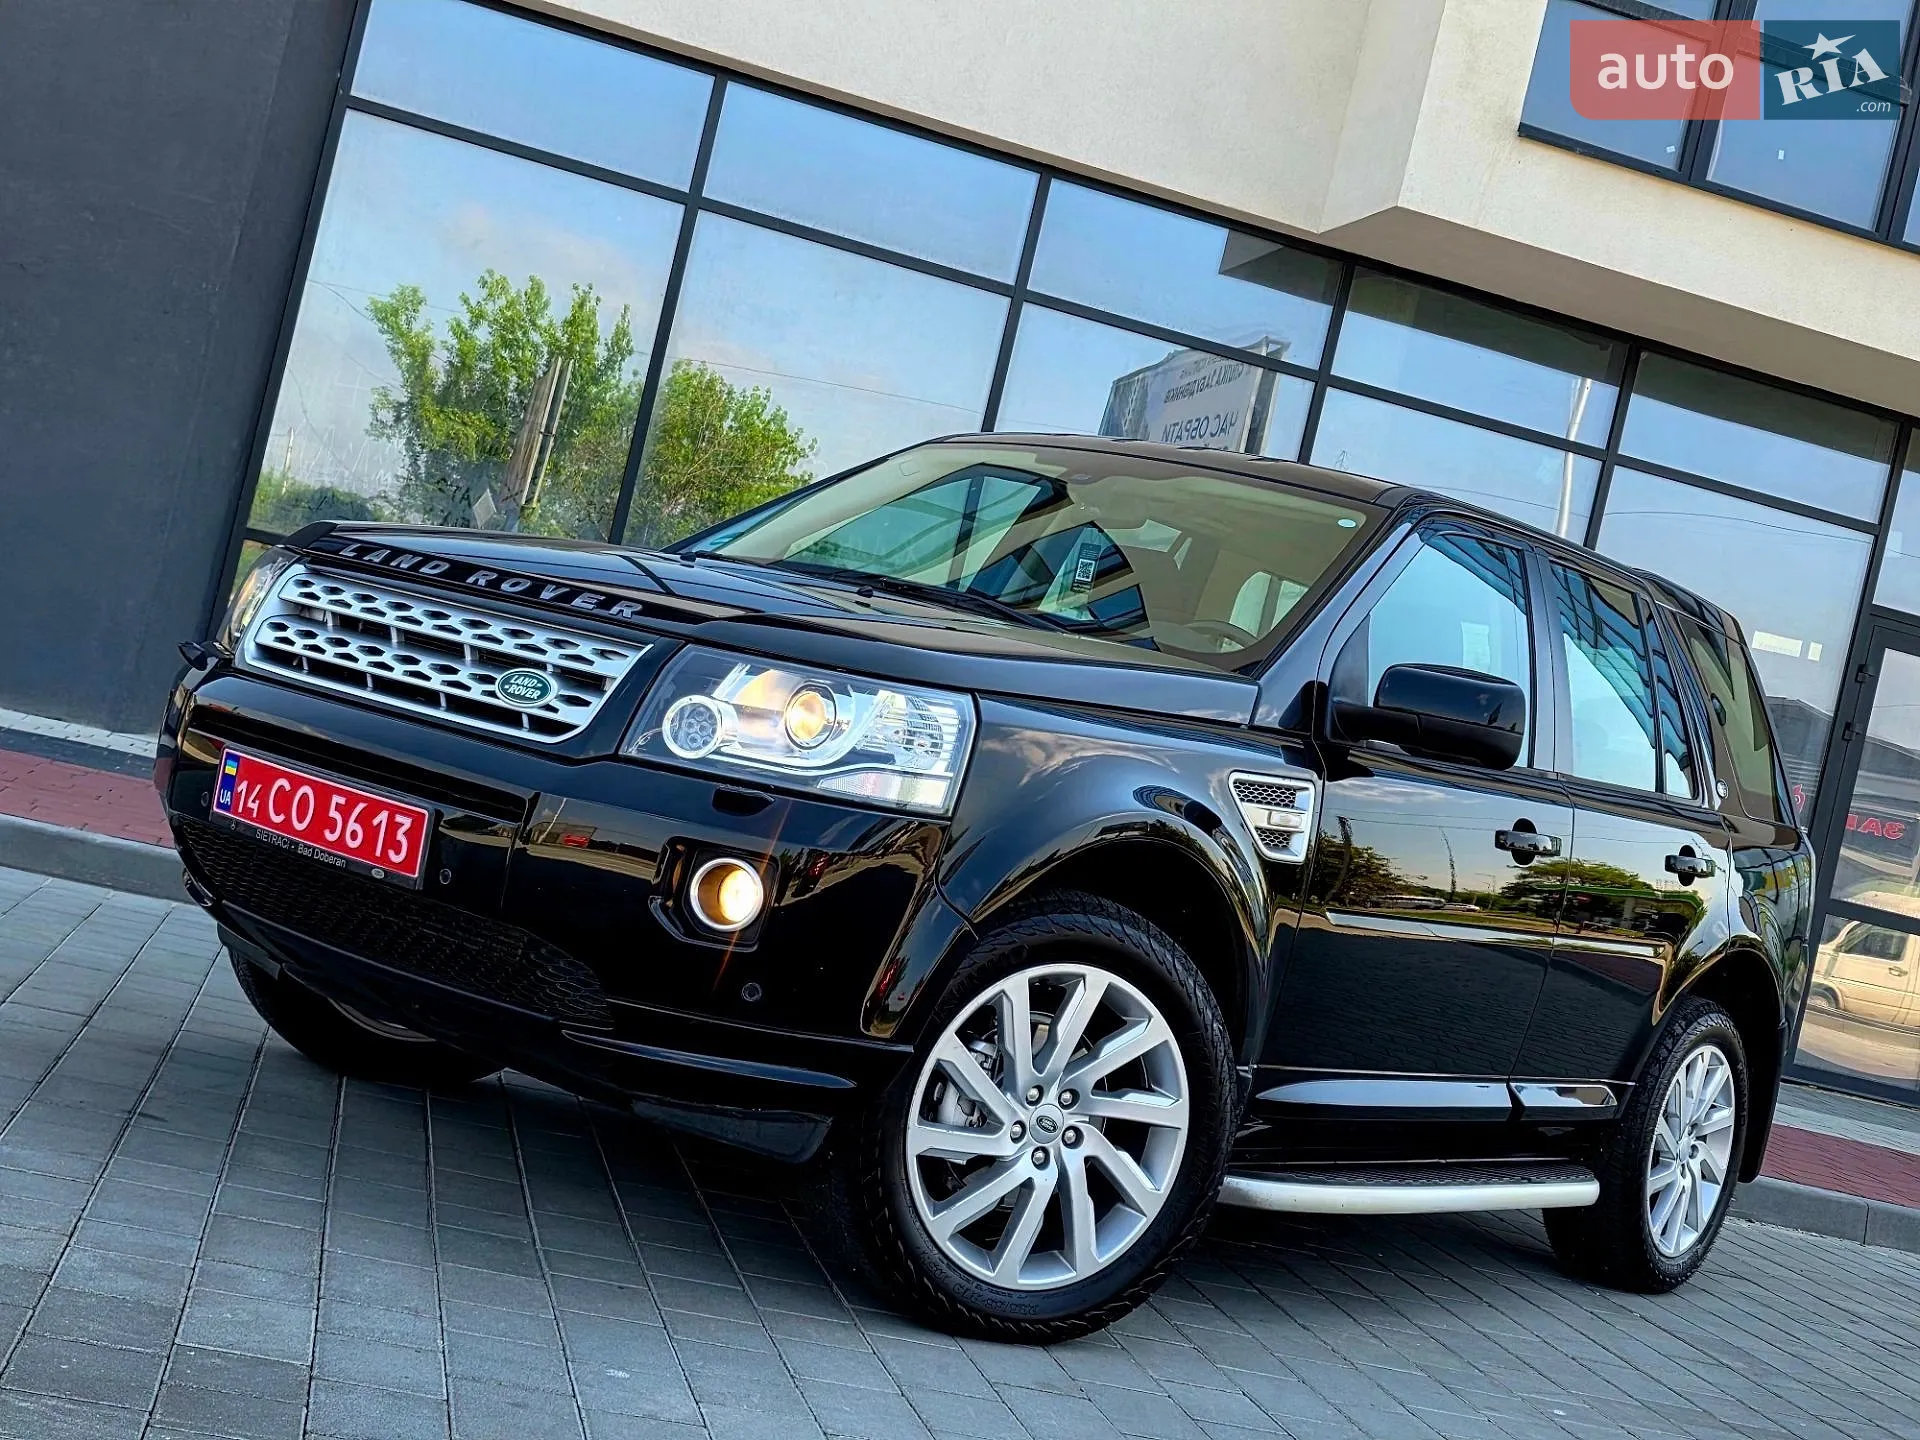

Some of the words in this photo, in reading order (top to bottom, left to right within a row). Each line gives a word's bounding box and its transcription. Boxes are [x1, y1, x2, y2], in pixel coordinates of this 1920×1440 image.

[338, 543, 450, 575] LAND
[466, 569, 645, 619] ROVER
[219, 788, 232, 806] UA
[236, 780, 263, 818] 14
[268, 778, 315, 831] CO
[323, 795, 413, 864] 5613
[297, 843, 313, 857] Bad
[313, 849, 347, 868] Doberan
